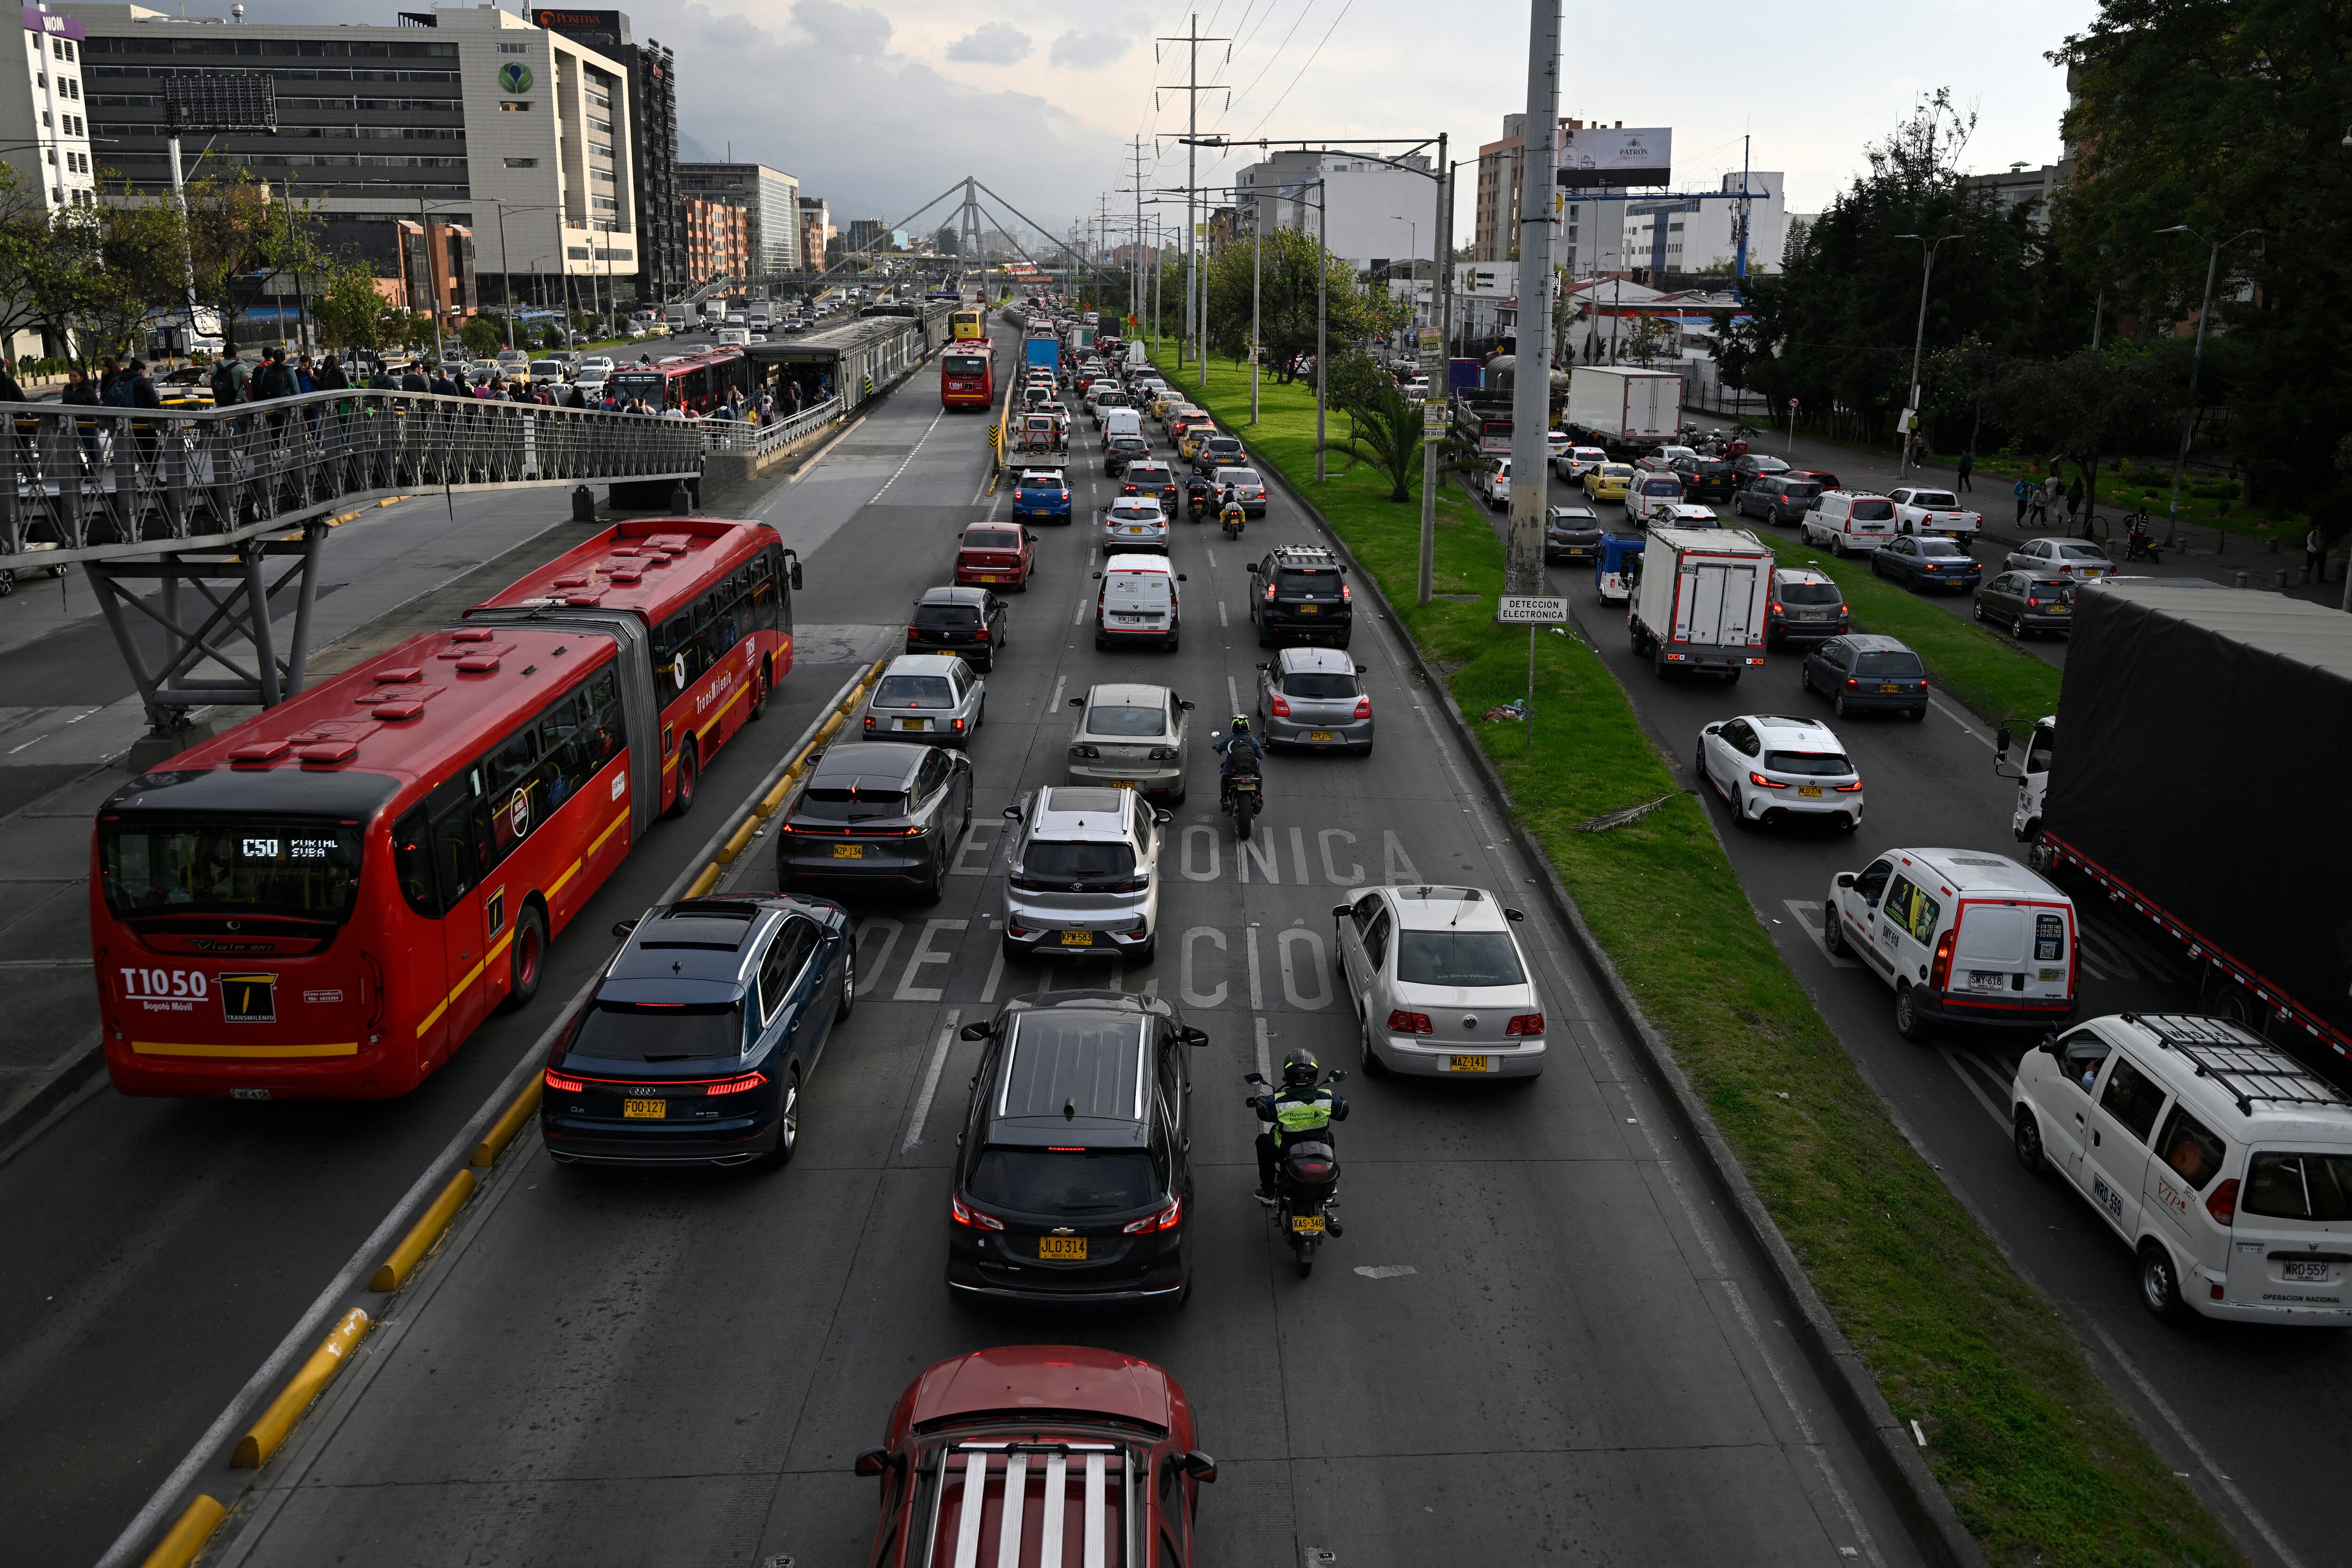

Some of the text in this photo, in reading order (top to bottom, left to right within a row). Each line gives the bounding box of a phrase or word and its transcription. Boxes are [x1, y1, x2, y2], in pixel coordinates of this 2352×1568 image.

[43, 16, 65, 31] WOM
[557, 13, 601, 24] POSITIVA
[1620, 147, 1648, 156] PATRÓN
[1510, 599, 1558, 609] DETECCIÓN
[1503, 609, 1563, 619] ELECTRÓNICA
[697, 670, 731, 715] TransMilenio
[243, 839, 278, 857] C50
[120, 968, 207, 997] T1050
[143, 1001, 192, 1012] Bogotá Móvil
[2160, 1175, 2179, 1195] Transporte
[2263, 1293, 2341, 1303] OPERACION NACIONAL
